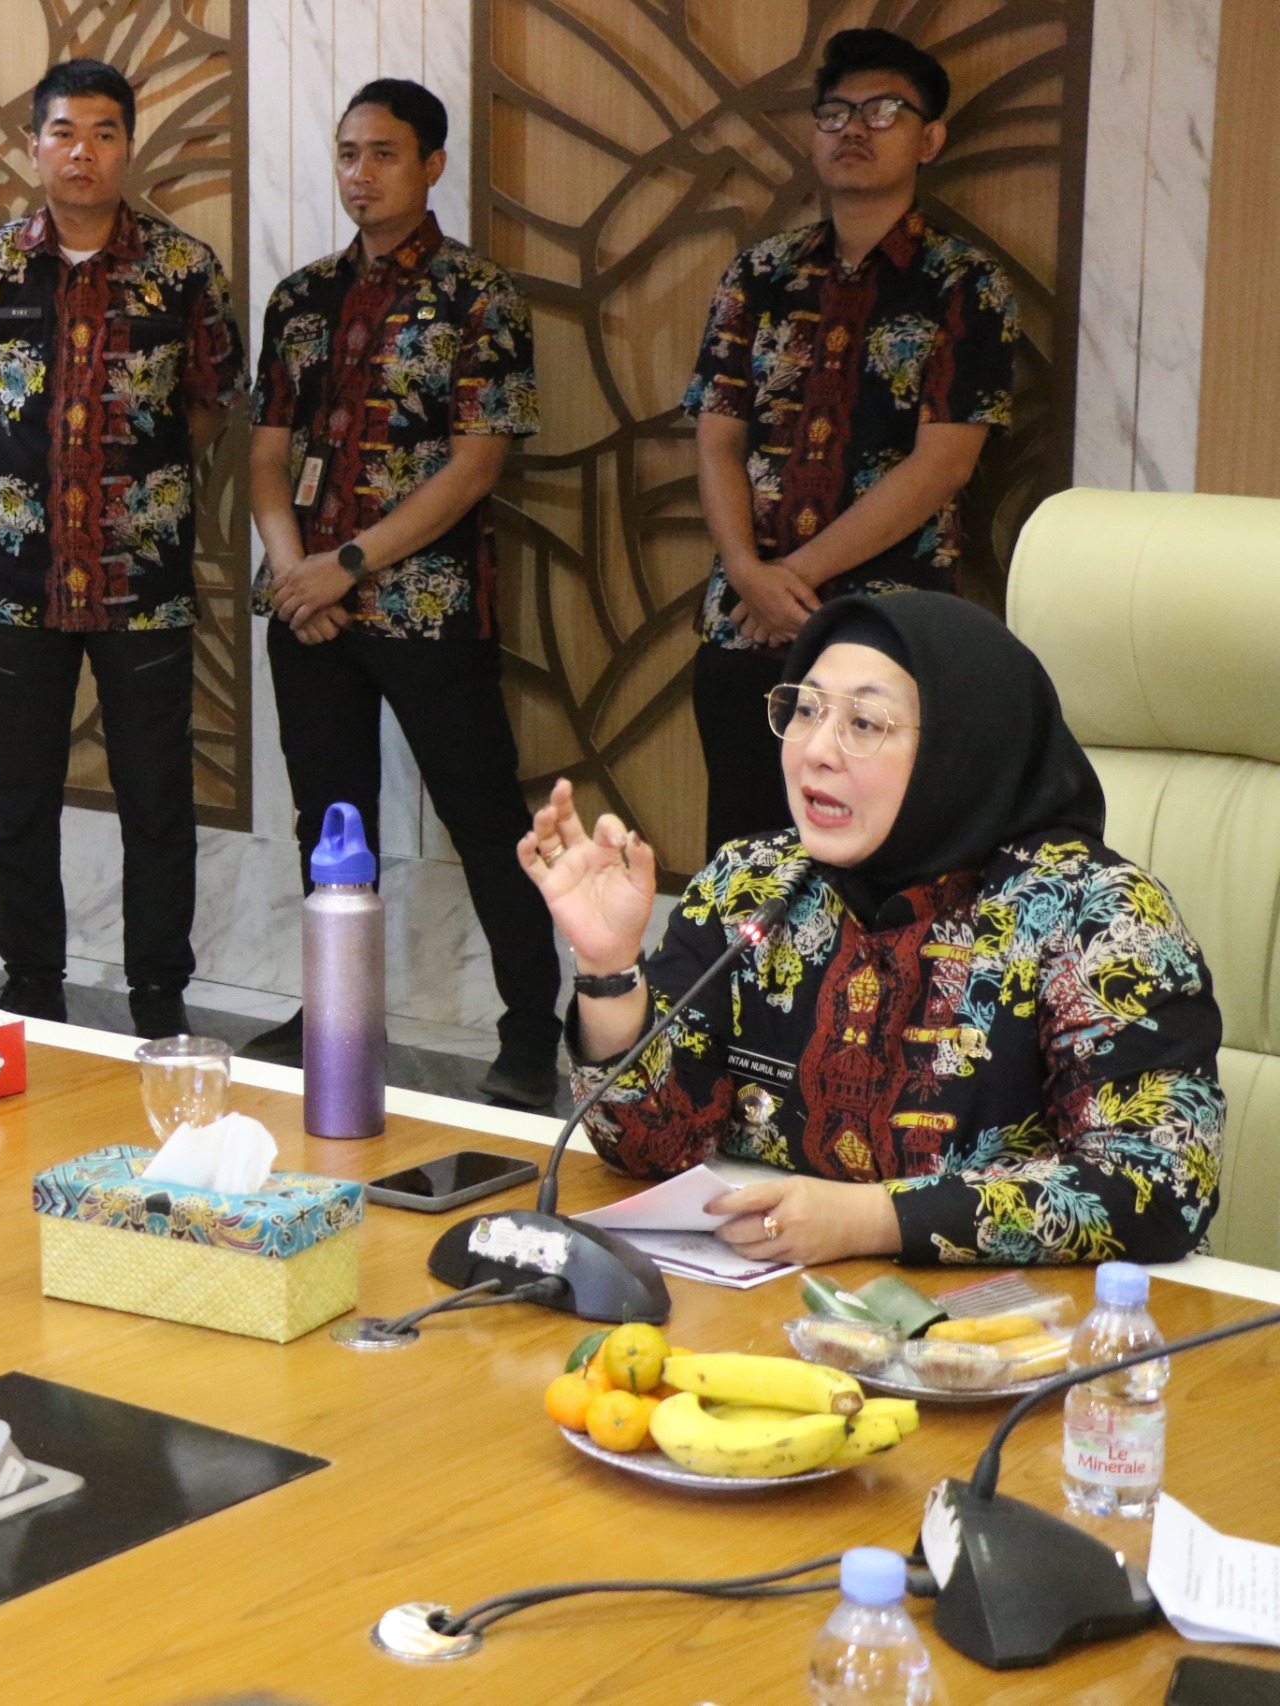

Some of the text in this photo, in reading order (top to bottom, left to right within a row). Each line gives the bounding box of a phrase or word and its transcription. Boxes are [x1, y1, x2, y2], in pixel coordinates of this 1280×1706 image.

[727, 1054, 750, 1068] INTAN
[750, 1061, 774, 1076] NURUL
[1108, 1444, 1128, 1461] Le
[1078, 1453, 1146, 1474] Minerale
